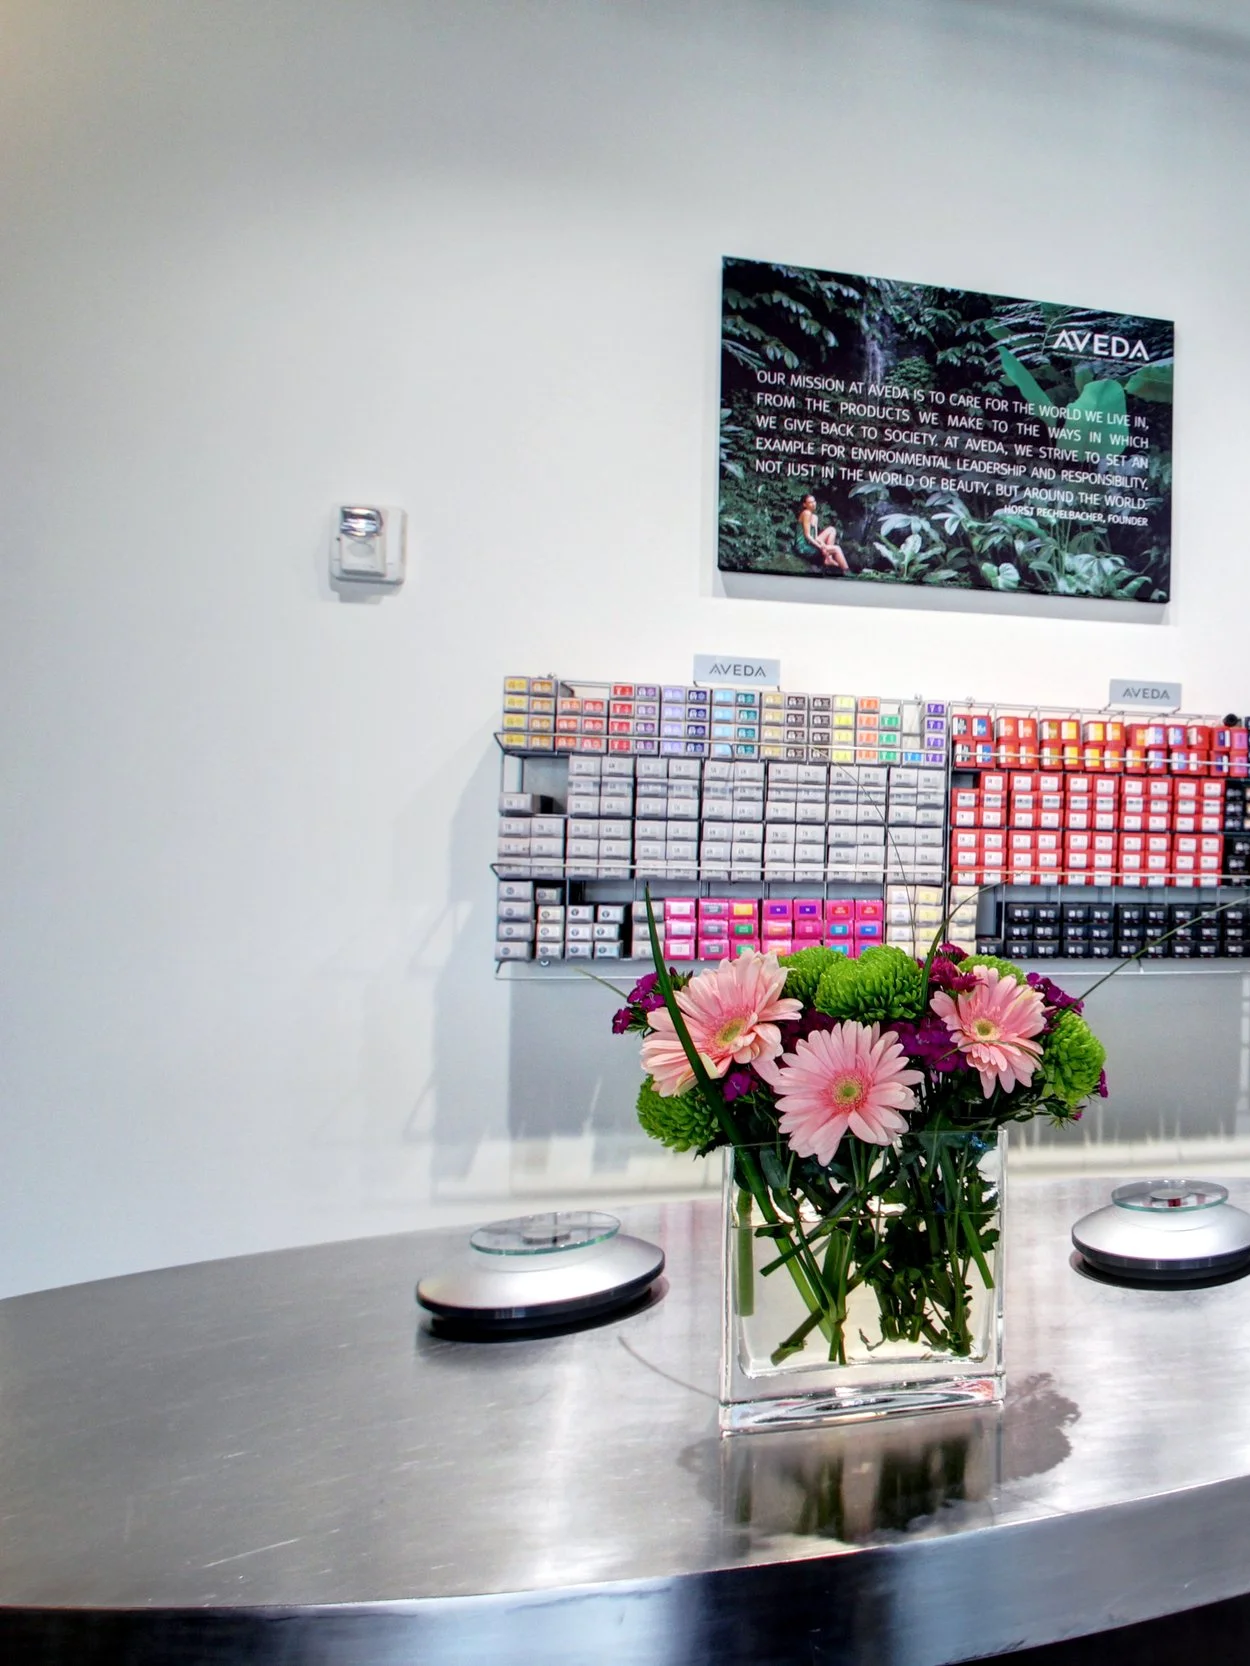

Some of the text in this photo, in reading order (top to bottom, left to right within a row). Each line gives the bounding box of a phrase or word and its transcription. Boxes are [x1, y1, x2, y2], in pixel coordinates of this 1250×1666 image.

[1052, 329, 1149, 361] AVEDA
[757, 370, 1149, 429] OUR MISSION AT AVEDA IS TO CARE FOR THE WORLD WE LIVE IN,
[757, 393, 1148, 448] FROM THE PRODUCTS WE MAKE TO THE WAYS IN WHICH
[756, 415, 776, 429] WE
[784, 418, 813, 433] GIVE
[821, 422, 854, 437] BACK
[861, 426, 877, 440] TO
[944, 436, 959, 449] AT
[1014, 445, 1033, 457] WE
[1039, 447, 1078, 462] STRIVE
[1085, 451, 1100, 464] TO
[1106, 454, 1127, 466] SET
[1132, 456, 1148, 468] AN
[756, 437, 814, 455] EXAMPLE
[821, 444, 845, 458] FOR
[852, 447, 951, 469] ENVIRONMENTAL
[957, 459, 1026, 476] LEADERSHIP
[1031, 467, 1055, 480] AND
[756, 460, 782, 473] NOT
[787, 463, 816, 477] JUST
[822, 467, 834, 479] IN
[840, 468, 863, 481] THE
[869, 471, 914, 486] WORLD
[920, 476, 936, 488] OF
[941, 479, 990, 496] BEAUTY,
[996, 485, 1019, 497] BUT
[1024, 487, 1073, 503] AROUND
[1078, 492, 1100, 505] THE
[1004, 505, 1034, 516] HORST
[1108, 515, 1148, 526] FOUNDER
[709, 663, 766, 678] AVEDA
[1122, 687, 1170, 701] AVEDA
